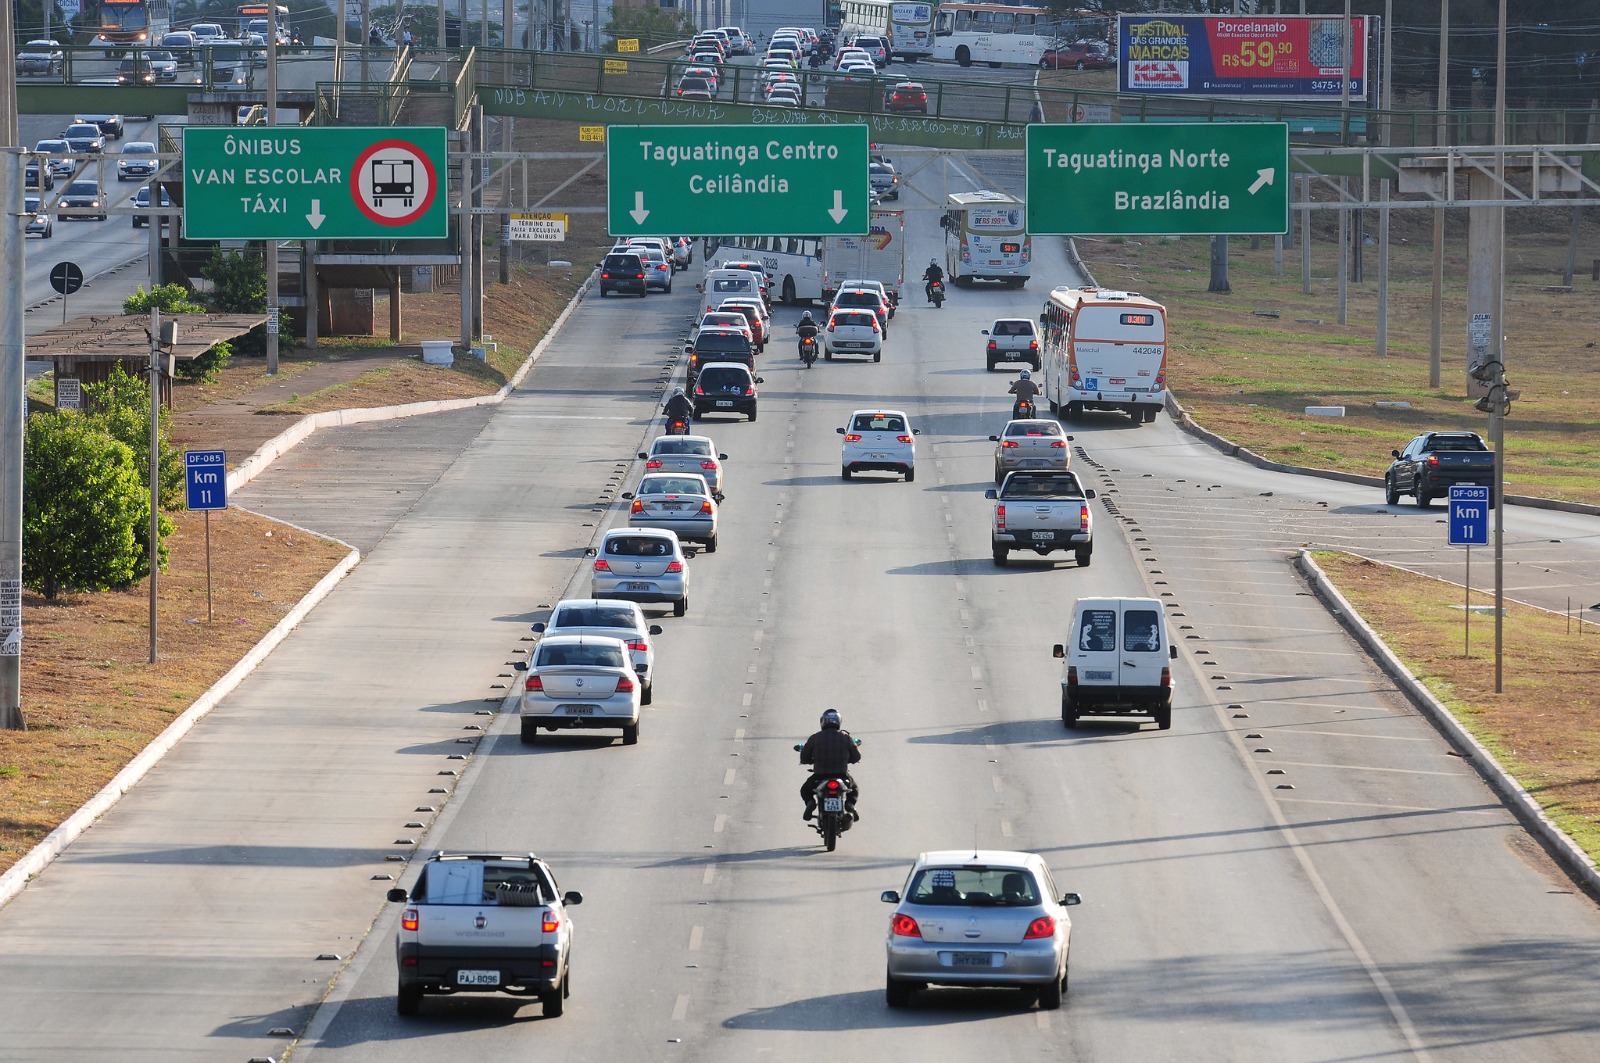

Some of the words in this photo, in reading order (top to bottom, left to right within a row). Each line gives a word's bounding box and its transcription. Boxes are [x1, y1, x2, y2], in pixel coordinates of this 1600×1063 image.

[1130, 24, 1188, 36] FESTIVAL
[1218, 22, 1286, 32] Porcelanato
[1129, 46, 1189, 59] MARCAS
[1312, 81, 1358, 90] 3475-10
[224, 134, 301, 155] ÔNIBUS
[640, 141, 758, 166] Taguatinga
[766, 141, 838, 160] Centro
[1043, 149, 1162, 174] Taguatinga
[1170, 148, 1230, 168] Norte
[192, 169, 235, 184] VAN
[245, 168, 341, 184] ESCOLAR
[690, 174, 788, 193] Ceilândia
[241, 193, 286, 213] TÁXI
[1115, 190, 1230, 210] Brazlândia
[194, 470, 217, 484] km
[201, 490, 211, 503] 11
[1457, 506, 1479, 518] km
[1463, 525, 1473, 538] 11
